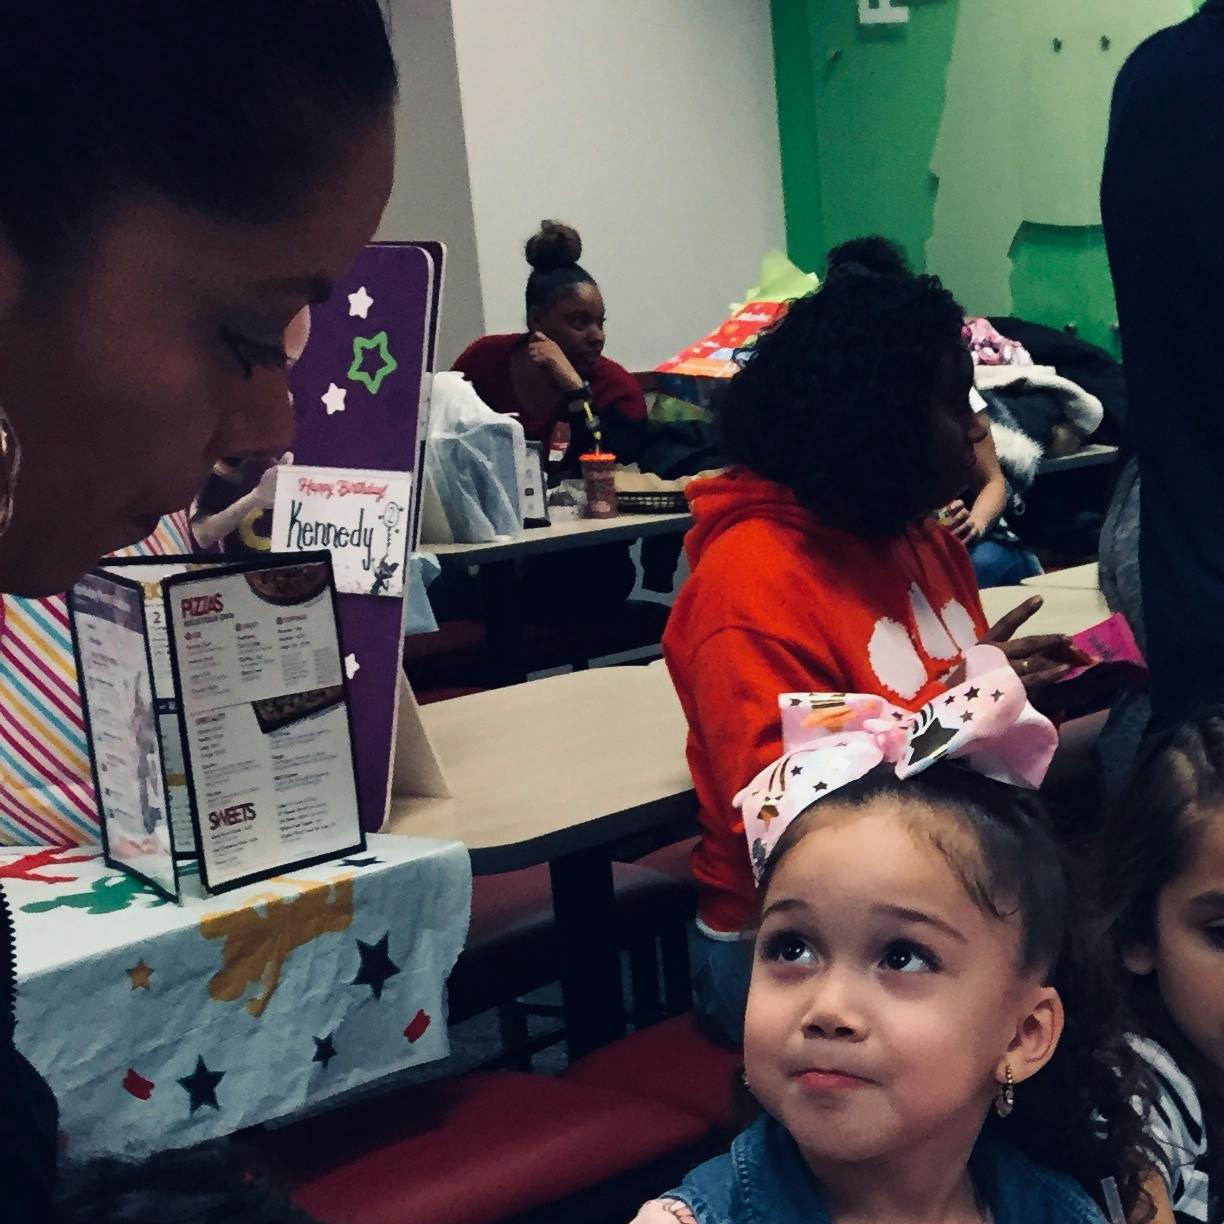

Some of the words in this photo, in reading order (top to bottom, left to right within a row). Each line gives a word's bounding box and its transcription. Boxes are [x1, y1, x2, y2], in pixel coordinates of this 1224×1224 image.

[286, 500, 374, 571] Kennedy
[181, 592, 225, 618] PIZZAS
[208, 802, 257, 831] SWEETS
